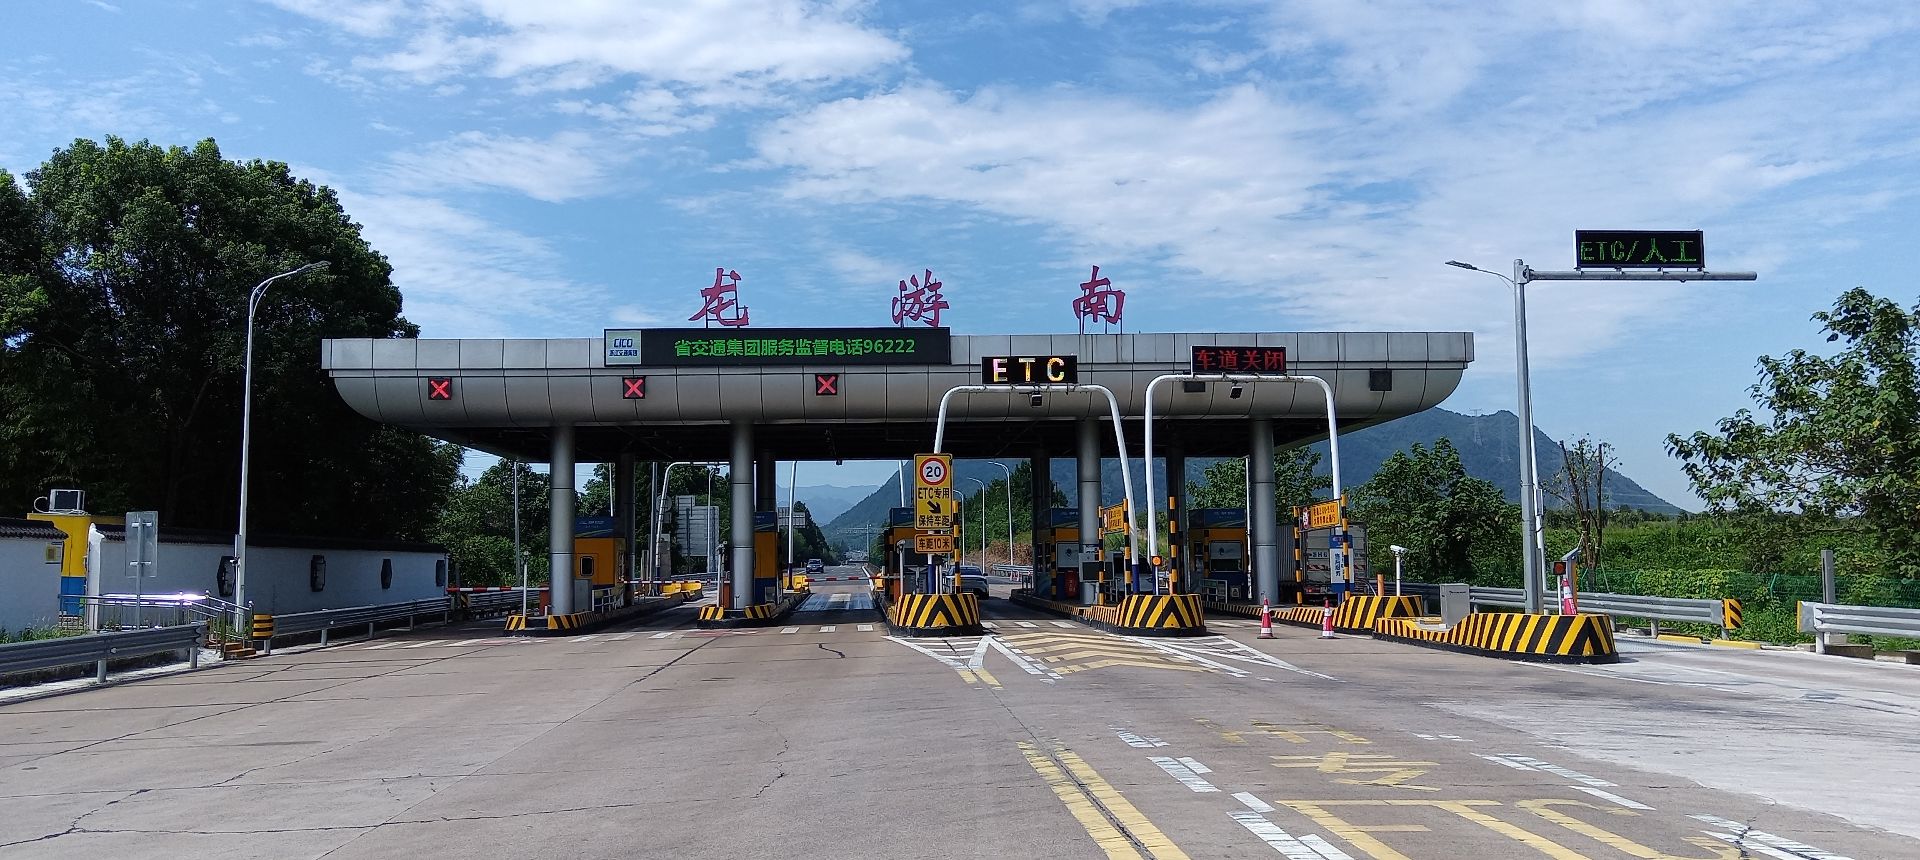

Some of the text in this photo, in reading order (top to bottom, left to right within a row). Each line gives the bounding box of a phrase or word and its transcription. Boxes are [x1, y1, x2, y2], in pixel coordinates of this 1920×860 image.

[1580, 238, 1698, 263] ETC/人工
[1073, 265, 1126, 325] 南
[674, 338, 916, 358] 省交通集团服务监督电话96222
[1196, 348, 1286, 371] 车道关闭
[993, 357, 1065, 383] ETC
[926, 466, 941, 478] 20
[918, 487, 950, 499] ETC专用
[919, 515, 950, 526] 保持车距
[919, 538, 950, 550] 车距10米
